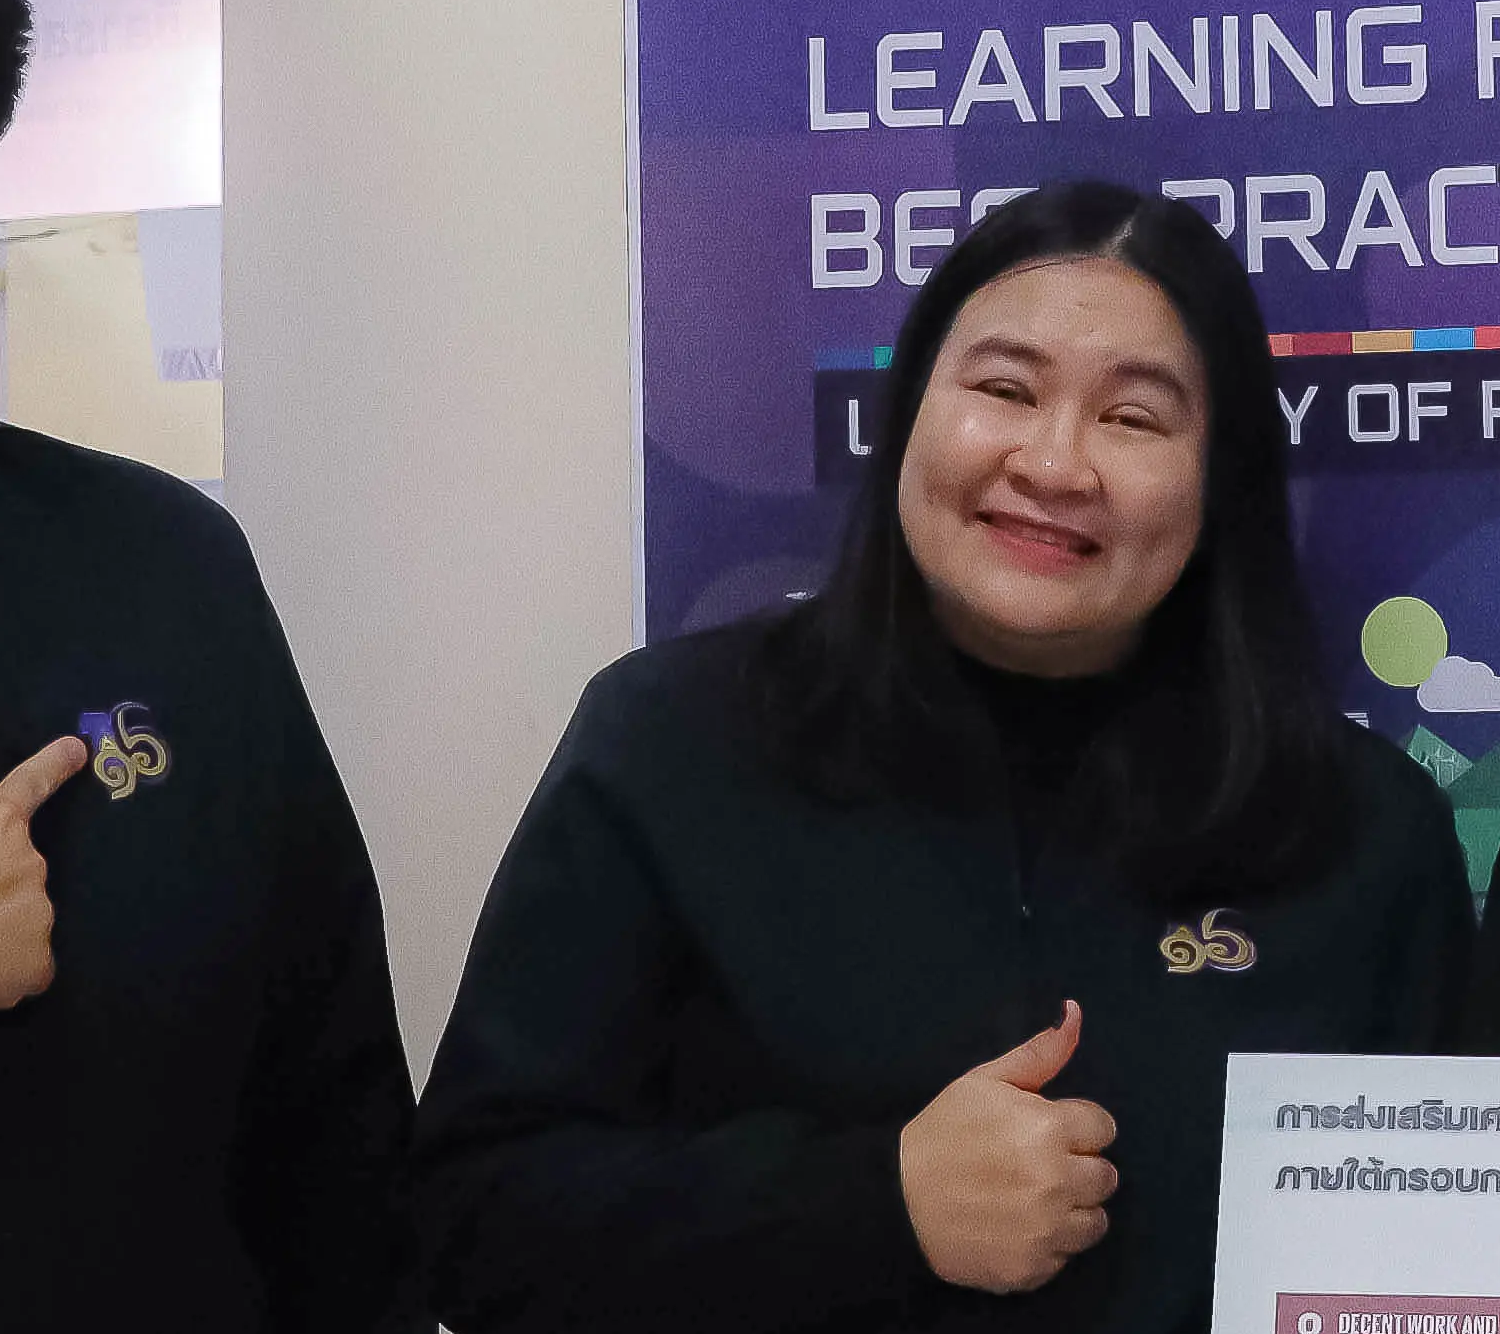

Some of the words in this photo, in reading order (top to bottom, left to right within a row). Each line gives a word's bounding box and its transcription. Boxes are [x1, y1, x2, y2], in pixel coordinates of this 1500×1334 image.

[808, 4, 1429, 132] LEARNING
[811, 187, 1040, 289] BE
[1347, 381, 1453, 444] OF
